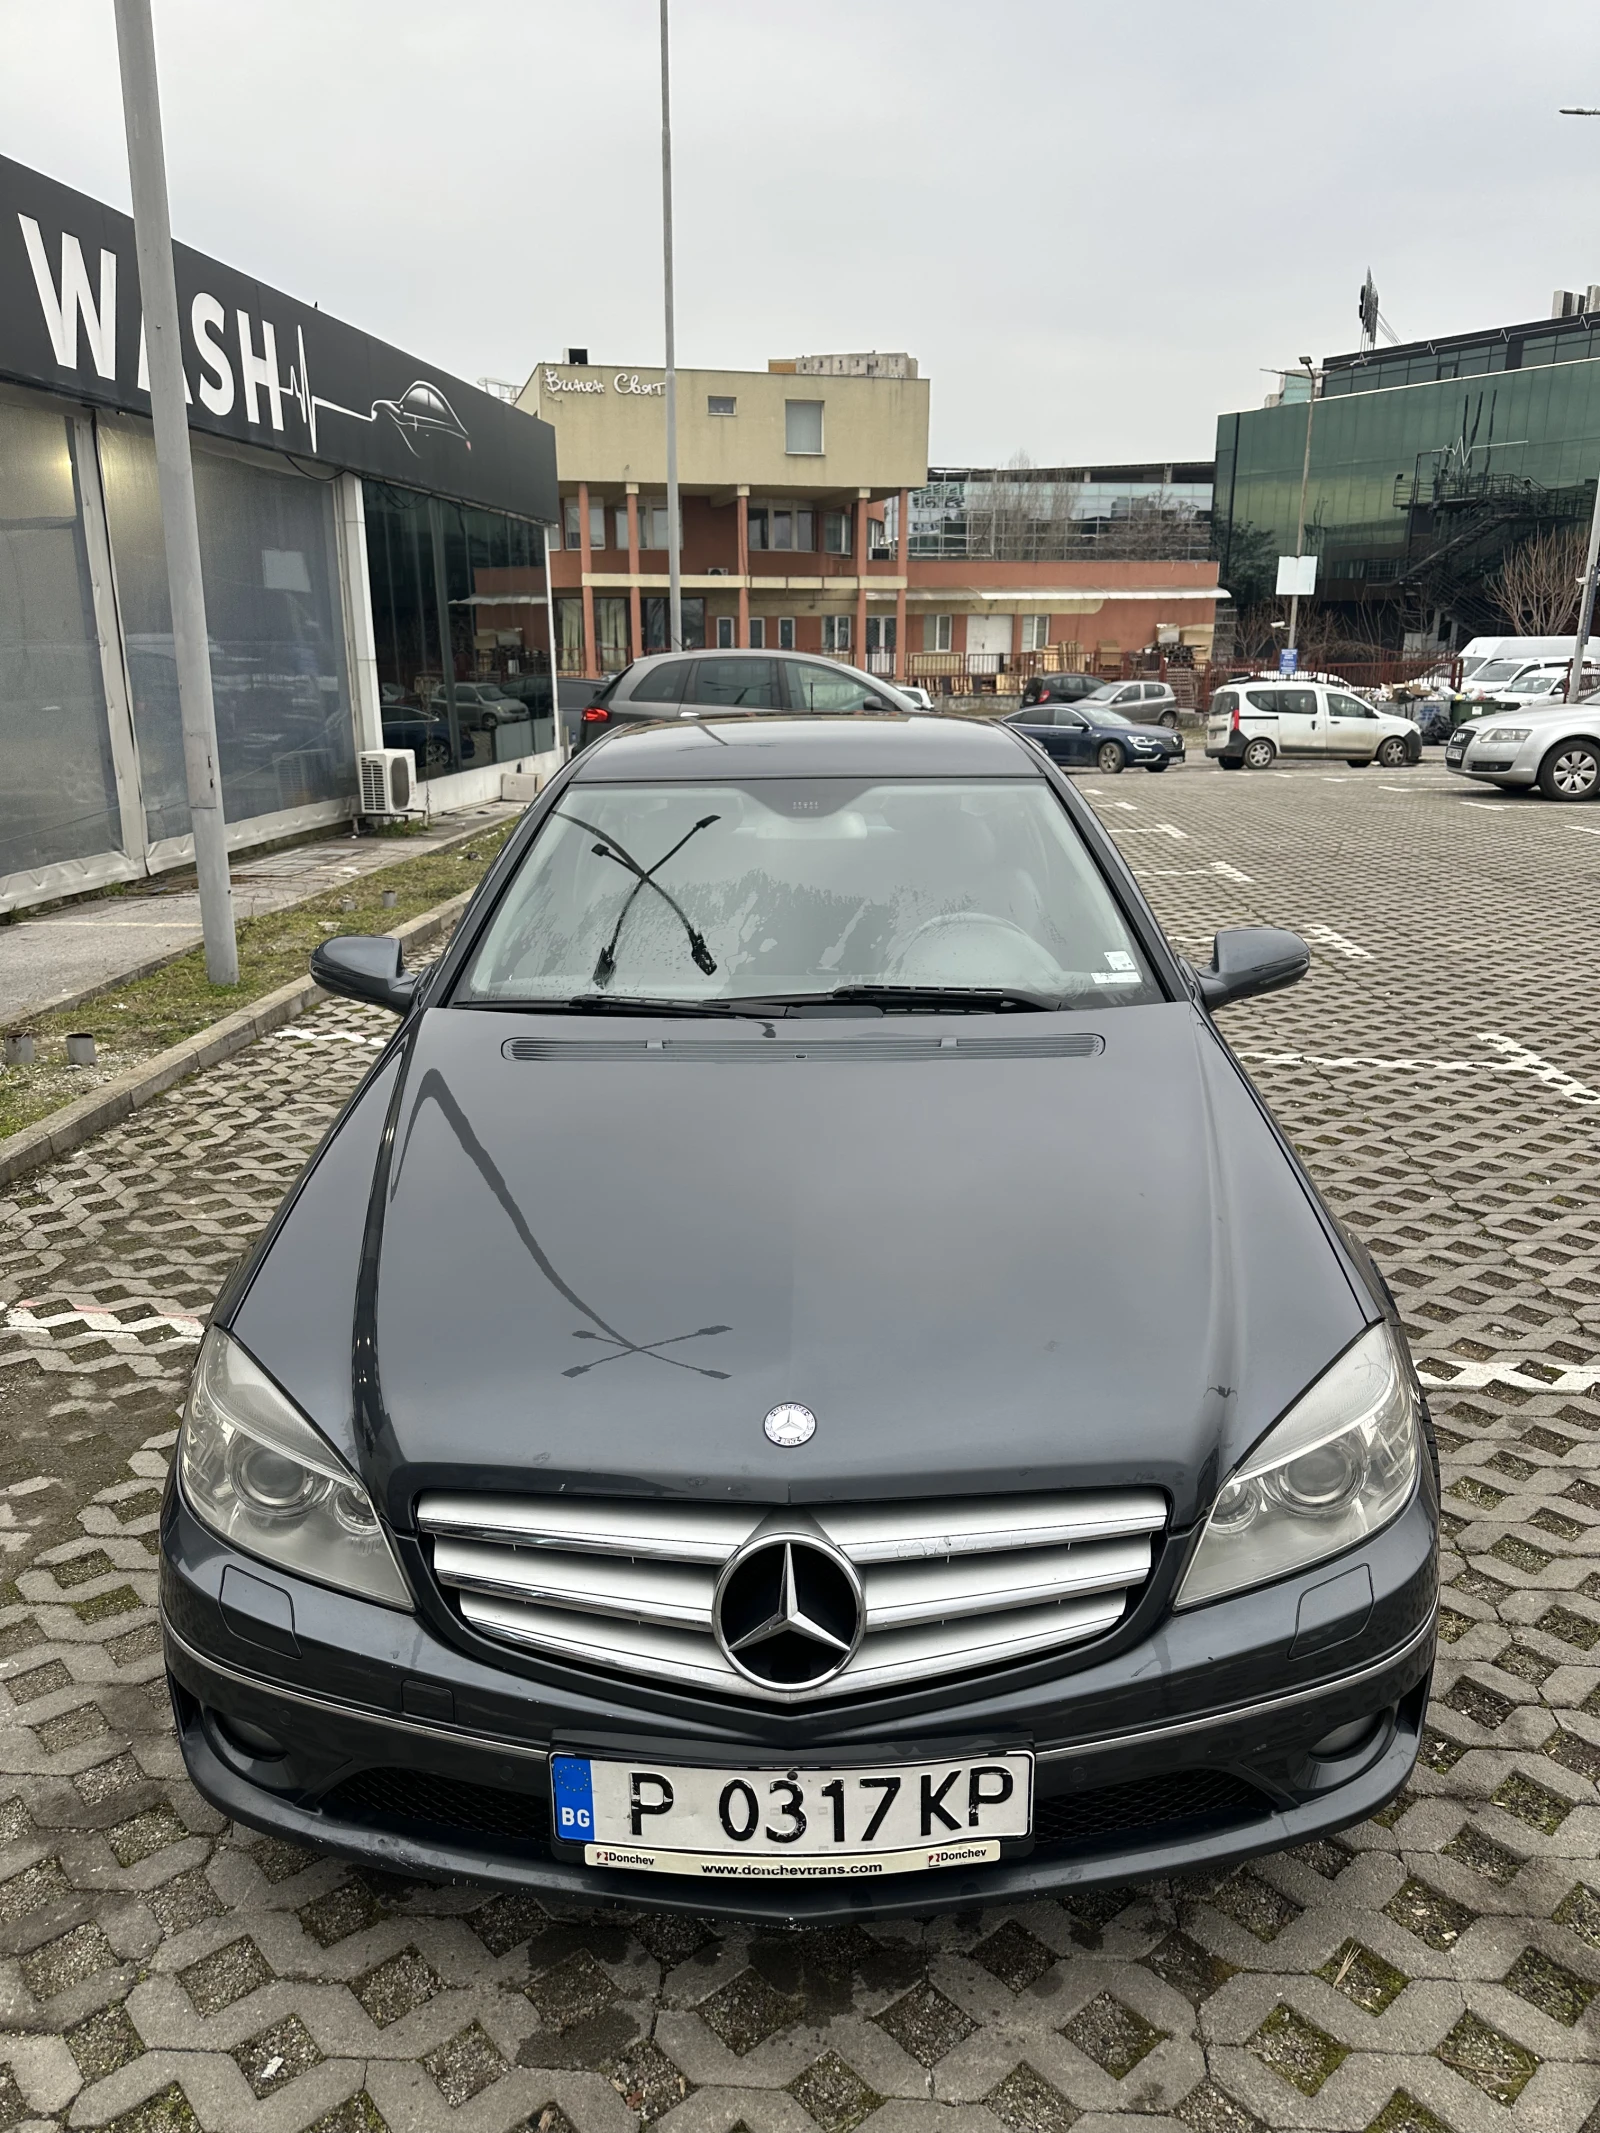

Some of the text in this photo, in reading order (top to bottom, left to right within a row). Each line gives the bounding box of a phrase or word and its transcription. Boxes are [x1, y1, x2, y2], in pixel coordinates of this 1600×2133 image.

[17, 212, 285, 431] WSH
[561, 1807, 590, 1827] BG
[630, 1772, 674, 1836] P
[608, 1852, 654, 1866] Donchev
[940, 1848, 987, 1862] Donchev
[701, 1863, 883, 1876] www.donchevtrans.com
